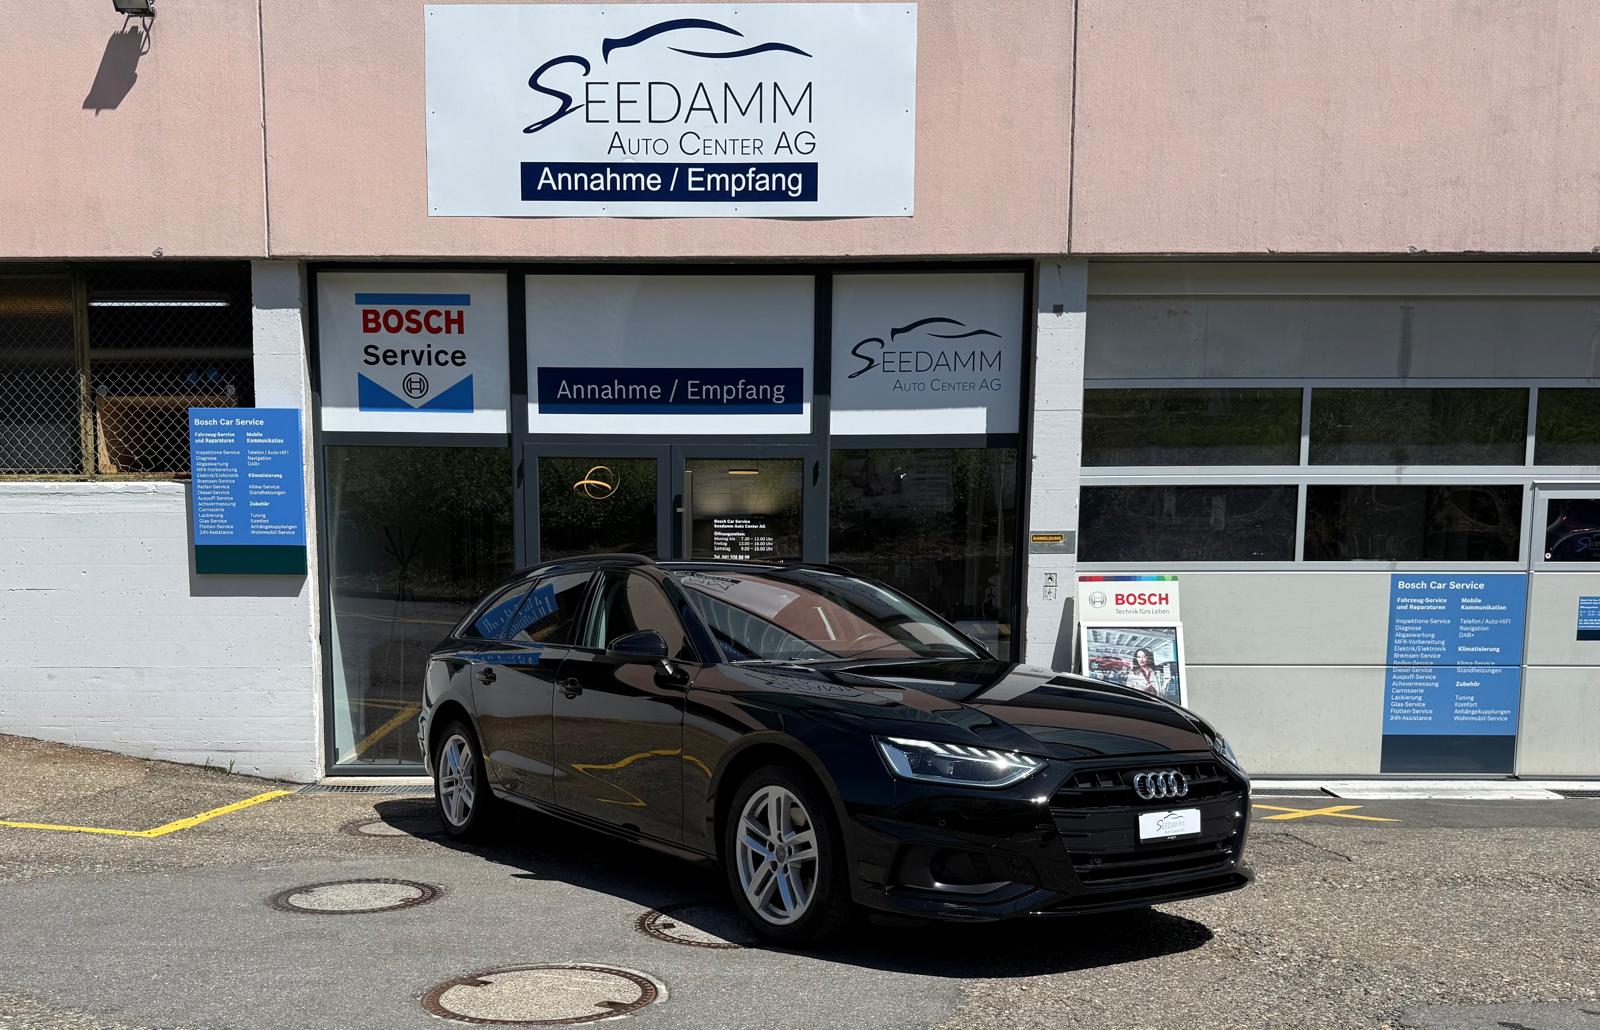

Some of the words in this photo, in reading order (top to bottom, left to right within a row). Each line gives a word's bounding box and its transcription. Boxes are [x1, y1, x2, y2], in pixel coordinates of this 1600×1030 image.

[522, 54, 813, 134] SEEDAMM
[607, 131, 669, 156] AUTO
[679, 131, 763, 156] CENTER
[774, 131, 817, 156] AG
[537, 166, 662, 192] Annahme
[669, 167, 679, 192] /
[687, 166, 803, 197] Empfang
[362, 308, 465, 334] BOSCH
[363, 344, 467, 367] Service
[847, 337, 1002, 379] SEEDAMM
[556, 380, 662, 400] Annahme
[669, 379, 679, 403] /
[687, 380, 786, 404] Empfang
[892, 379, 926, 392] AUTO
[930, 379, 976, 392] CENTER
[978, 378, 1002, 392] AG
[194, 418, 217, 426] Bosch
[220, 418, 234, 426] Car
[235, 418, 265, 426] Service
[1397, 580, 1427, 589] Bosch
[1429, 580, 1447, 589] Car
[1449, 580, 1485, 590] Service
[1114, 593, 1169, 606] BOSCH
[1456, 666, 1502, 674] Standheizungen
